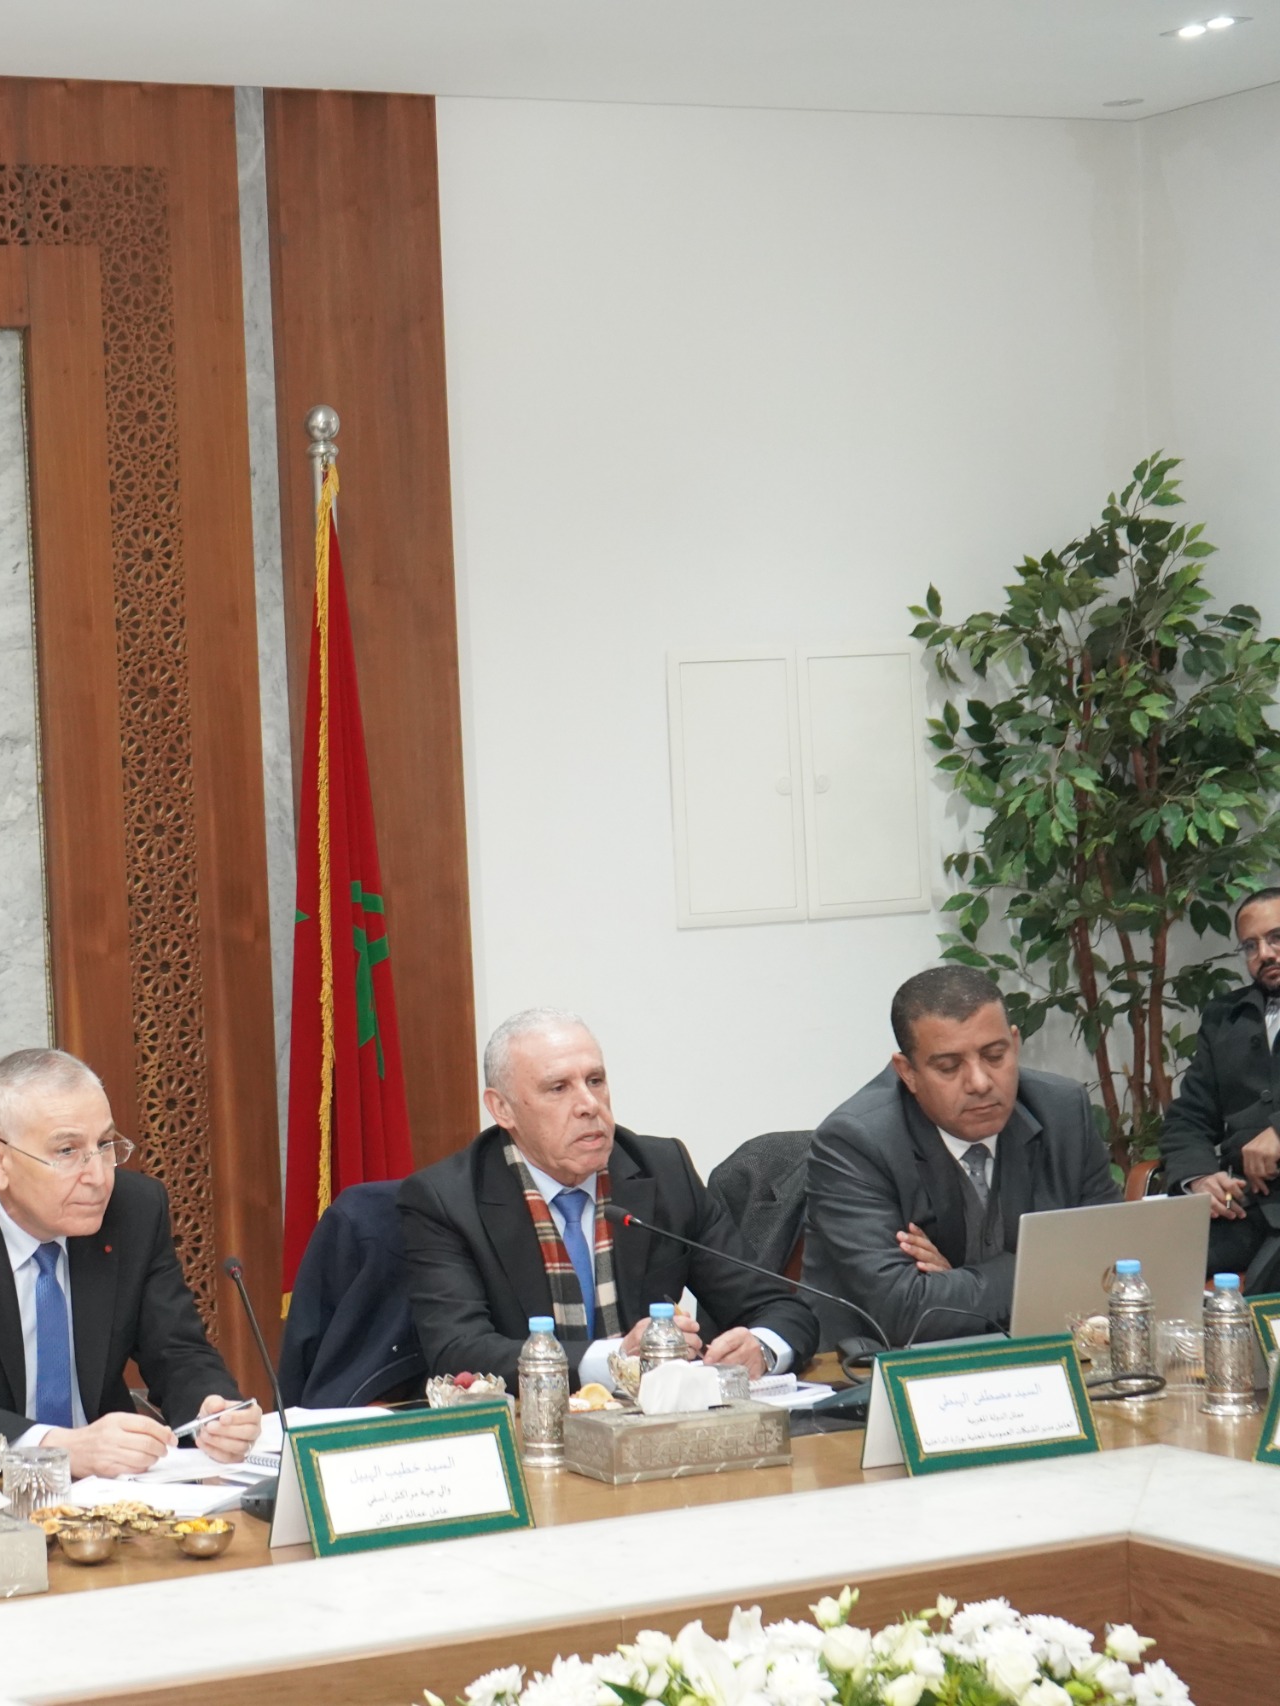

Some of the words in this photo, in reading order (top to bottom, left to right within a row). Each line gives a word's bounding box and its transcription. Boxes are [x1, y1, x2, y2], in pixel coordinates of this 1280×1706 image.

[384, 1461, 421, 1479] خطيب
[424, 1455, 456, 1473] السيد
[420, 1487, 435, 1498] جهة
[405, 1508, 427, 1519] عمالة
[428, 1506, 448, 1518] عامل
[375, 1512, 404, 1526] مراكش
